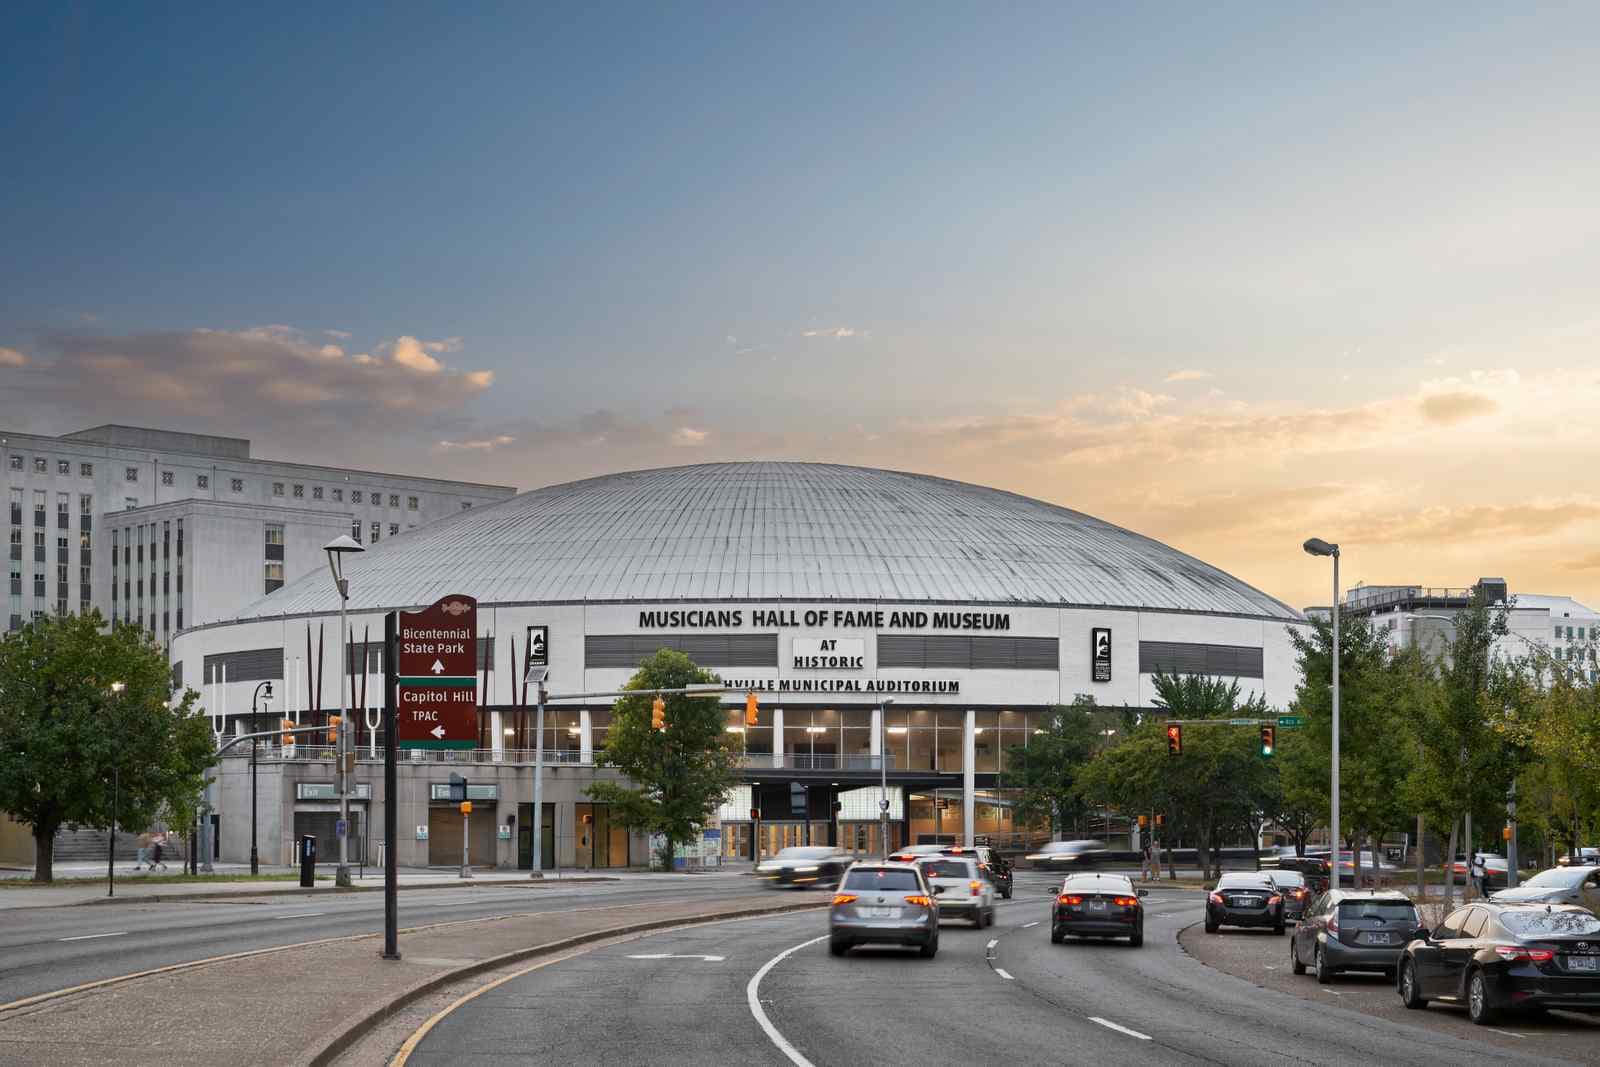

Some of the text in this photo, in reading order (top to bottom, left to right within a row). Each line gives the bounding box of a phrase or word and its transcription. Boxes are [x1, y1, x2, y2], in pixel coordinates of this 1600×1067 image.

[639, 610, 1010, 631] MUSICIANS HALL OF FAME AND MUSEUM
[403, 628, 470, 640] Bicentennial
[403, 643, 464, 654] State Park
[820, 639, 837, 651] AT
[793, 656, 863, 668] HISTORIC
[779, 679, 861, 691] MUNICIPAL
[865, 680, 960, 692] AUDITORIUM
[403, 691, 475, 704] Capitol Hill
[412, 710, 438, 721] TPAC
